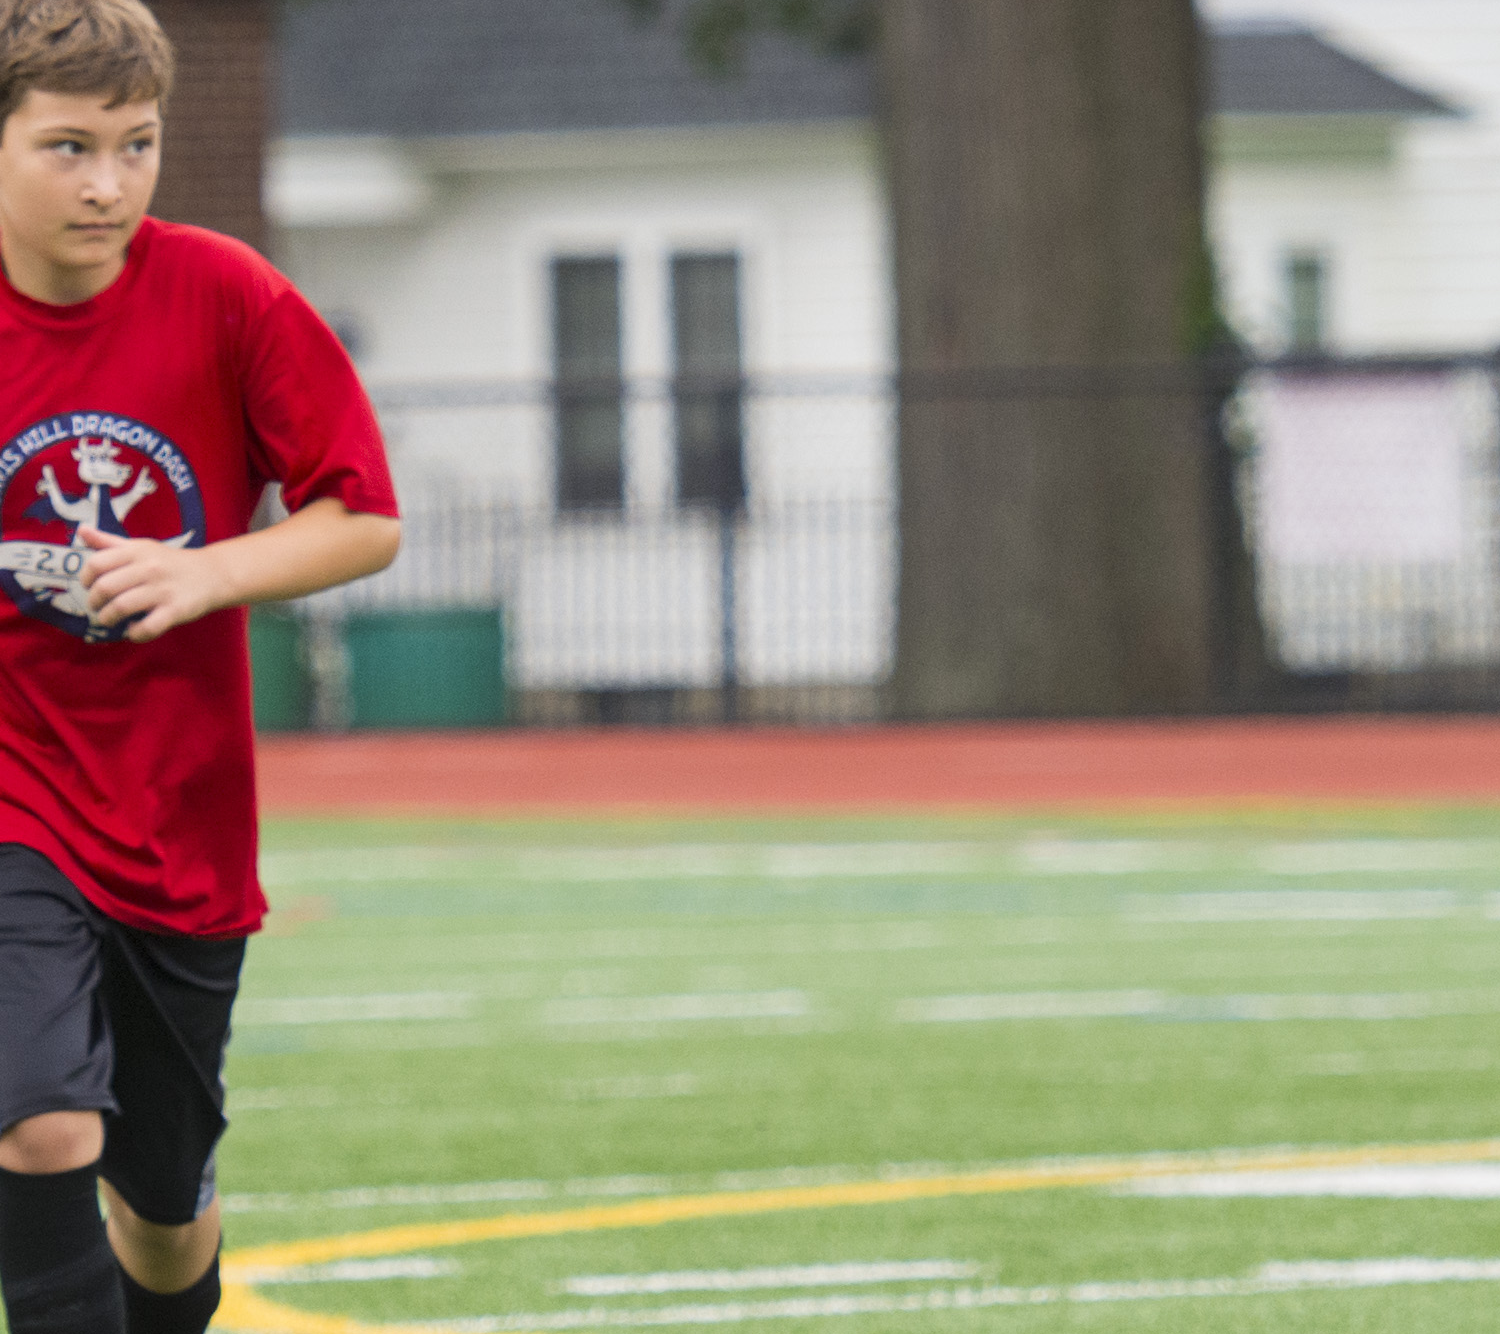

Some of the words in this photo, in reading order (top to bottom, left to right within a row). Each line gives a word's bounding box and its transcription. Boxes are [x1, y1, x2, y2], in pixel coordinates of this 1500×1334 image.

[16, 419, 69, 455] HILL
[71, 414, 161, 453] DRAGON
[153, 443, 194, 493] DASH
